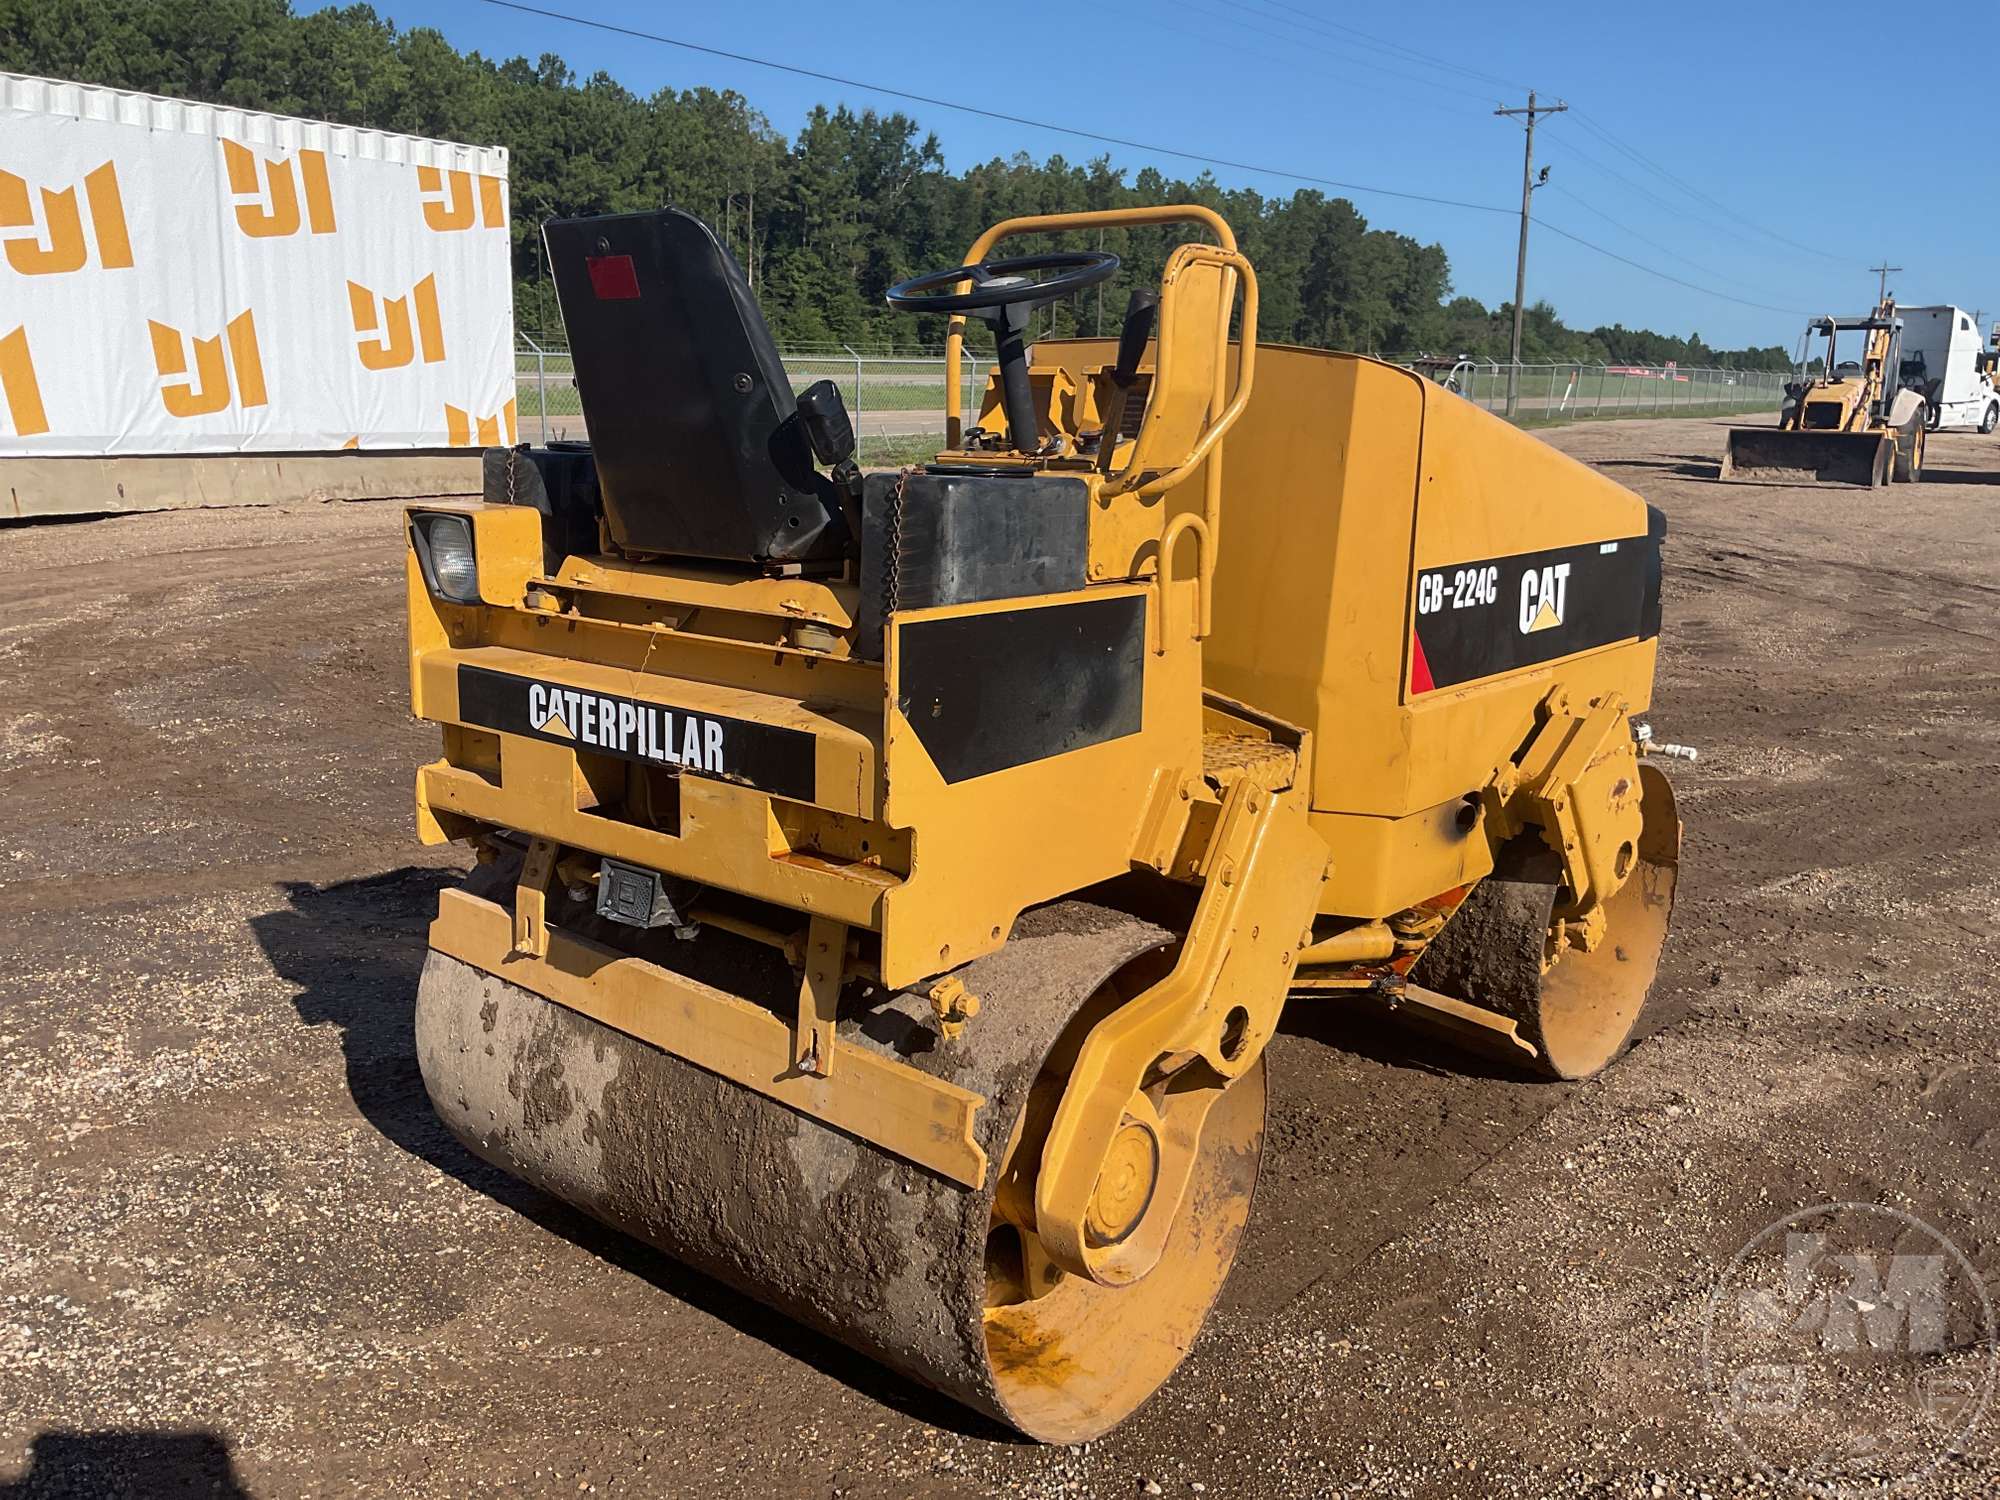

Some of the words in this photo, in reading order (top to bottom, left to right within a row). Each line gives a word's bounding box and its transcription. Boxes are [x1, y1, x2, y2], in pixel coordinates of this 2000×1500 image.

[1418, 566, 1498, 615] CB-224C
[1519, 562, 1571, 635] CAT
[529, 683, 725, 774] CATERPILLAR
